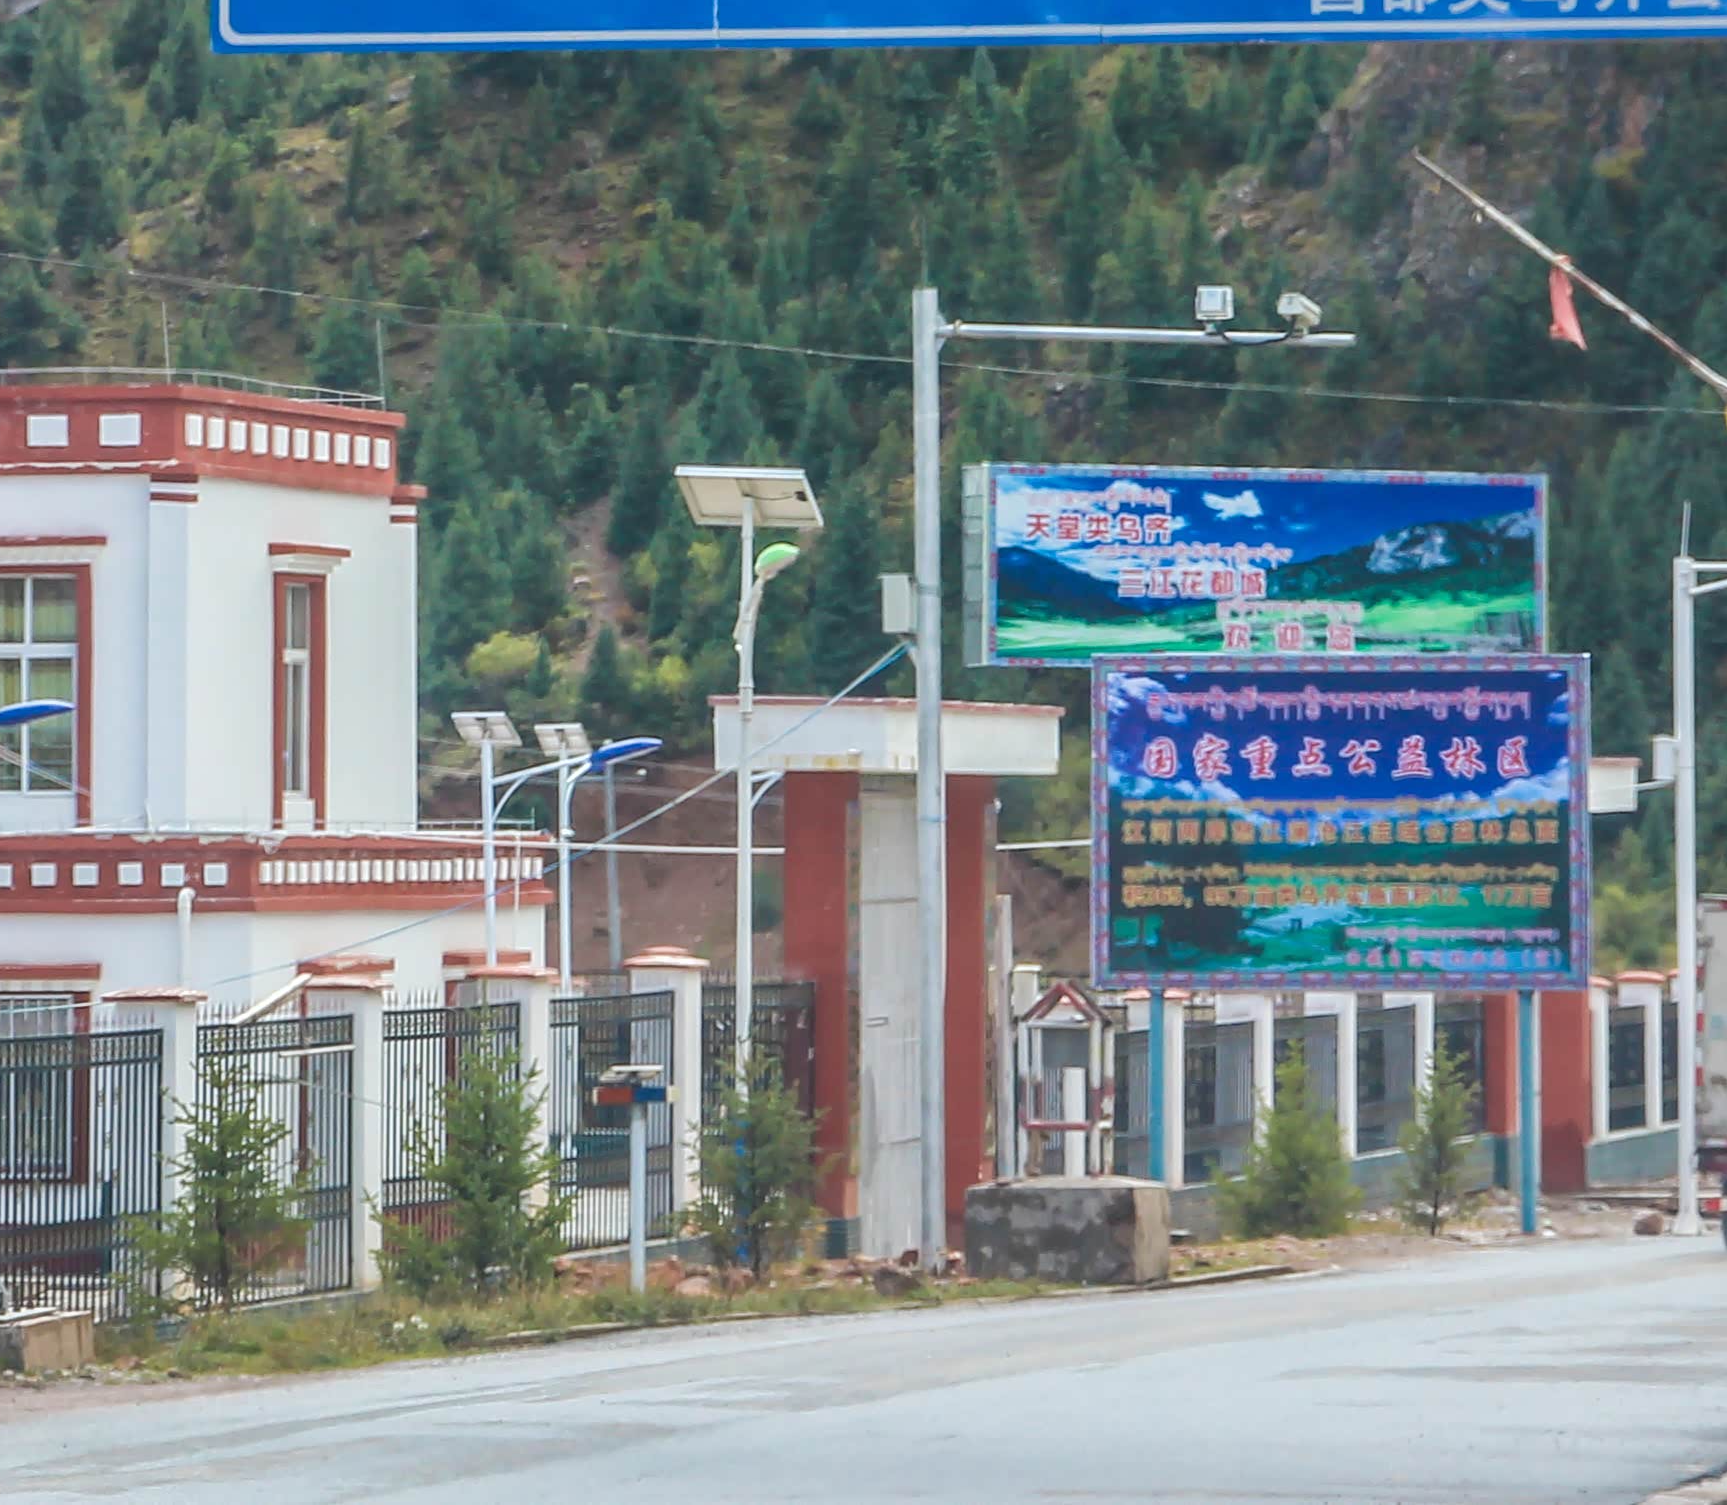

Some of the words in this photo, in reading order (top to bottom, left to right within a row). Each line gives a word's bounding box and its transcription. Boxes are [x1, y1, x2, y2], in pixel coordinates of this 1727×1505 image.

[1026, 513, 1173, 542] 天堂类乌齐
[1143, 733, 1531, 782] 国家重点公益林区
